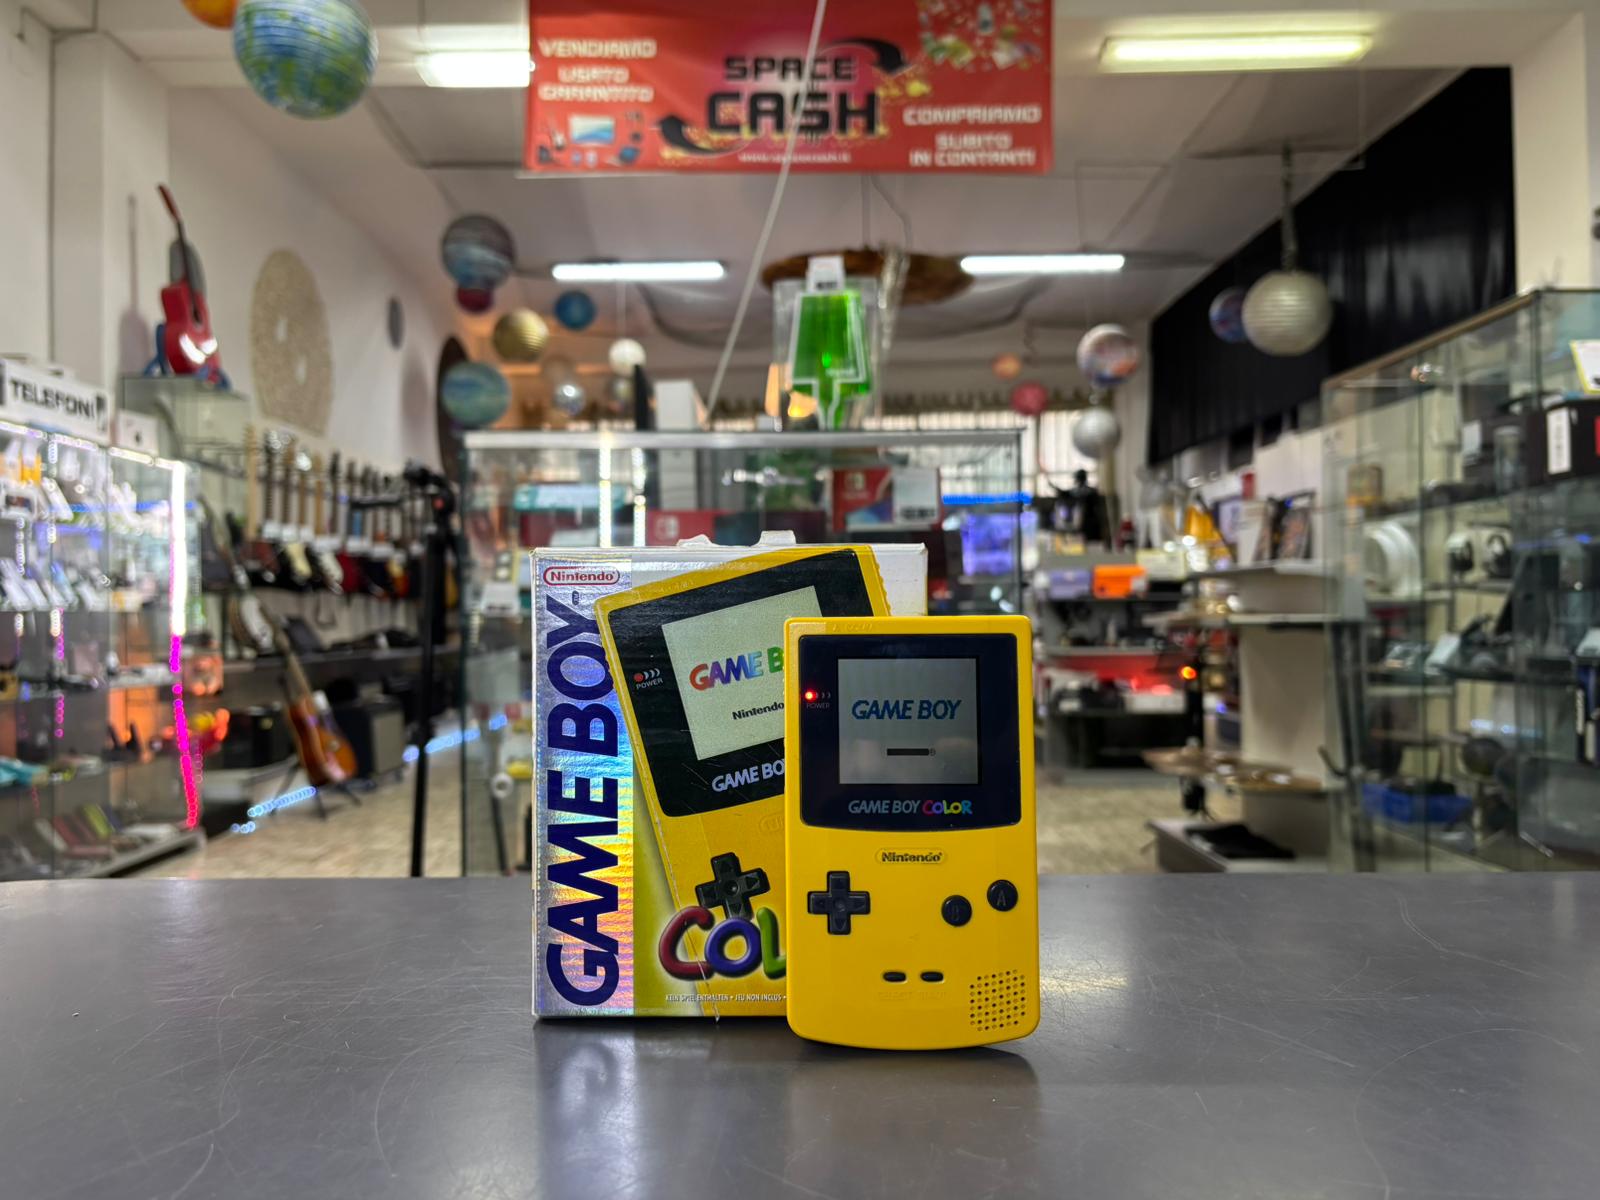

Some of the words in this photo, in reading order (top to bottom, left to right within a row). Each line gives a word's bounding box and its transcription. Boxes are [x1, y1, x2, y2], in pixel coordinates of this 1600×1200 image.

[537, 38, 657, 59] VENDIAMO
[724, 57, 855, 81] SPACE
[903, 104, 1042, 125] COMPRIAMO
[935, 131, 1013, 150] SUBITO
[909, 149, 931, 167] IN
[934, 148, 1036, 167] CONTANTI
[11, 377, 95, 418] TELEFONI
[550, 571, 614, 582] Nintendo
[546, 594, 620, 758] BOY
[689, 651, 764, 692] GAME
[636, 677, 664, 690] POWER
[732, 701, 785, 720] Nintendo
[851, 699, 914, 720] GAME
[917, 699, 962, 720] BOY
[711, 765, 760, 793] GAME
[761, 758, 785, 780] BO
[848, 799, 892, 814] GAME
[891, 799, 921, 814] BOY
[922, 799, 973, 815] COLOR
[881, 852, 942, 863] Nintendo
[546, 769, 620, 1006] GAME
[747, 994, 760, 1003] NON
